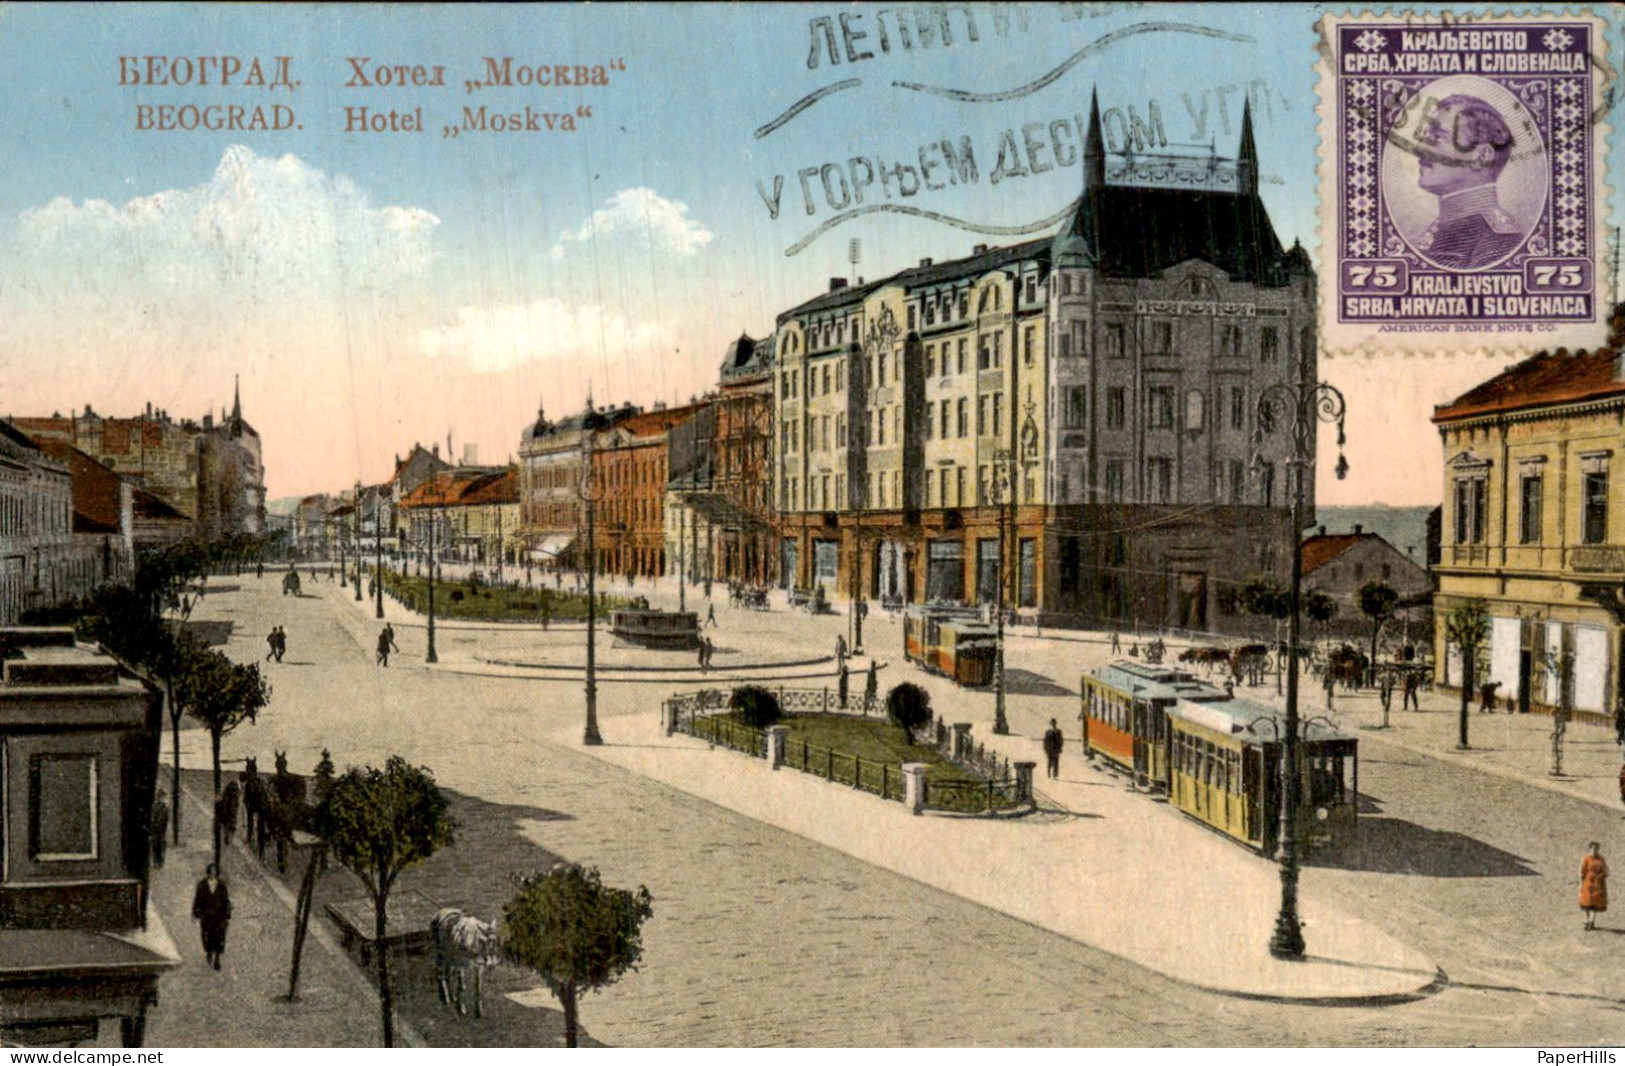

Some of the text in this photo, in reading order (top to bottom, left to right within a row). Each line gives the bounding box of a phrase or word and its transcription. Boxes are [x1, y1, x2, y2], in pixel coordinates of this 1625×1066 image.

[1401, 31, 1528, 51] КРАЉЕВСТВО
[1466, 53, 1477, 73] И
[1481, 53, 1586, 75] СЛОВЕНАЦА
[756, 174, 784, 220] У
[798, 134, 980, 216] ГОРЊЕМ
[1349, 264, 1583, 296] 75 KRALJEVSTVO 75
[1471, 297, 1480, 317] I
[1483, 297, 1588, 317] SLOVENACA
[1377, 323, 1559, 335] AMERICAN BANK NOTE CO.
